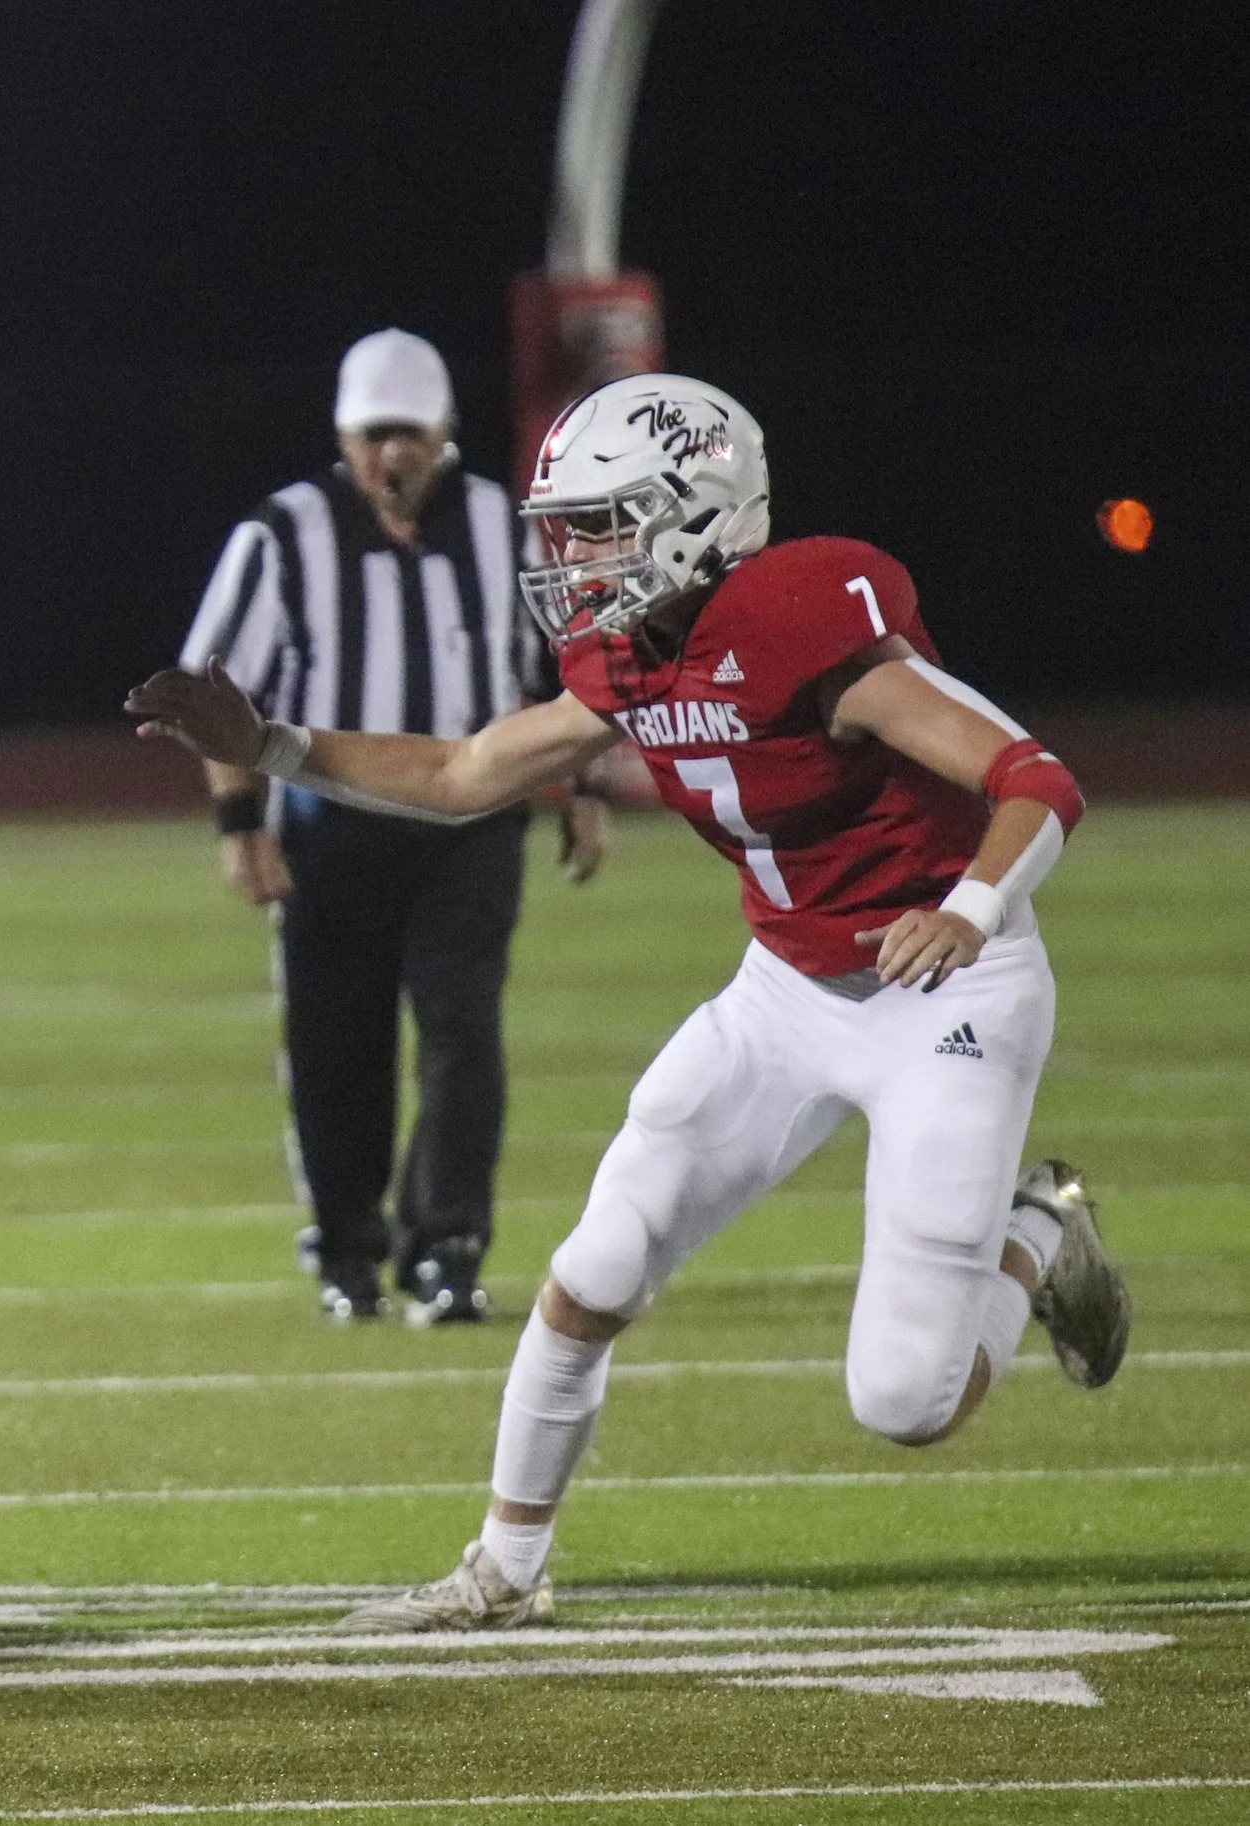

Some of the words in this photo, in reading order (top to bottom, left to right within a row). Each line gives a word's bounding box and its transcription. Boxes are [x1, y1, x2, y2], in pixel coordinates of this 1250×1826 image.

[627, 399, 686, 438] The
[661, 421, 733, 469] Hill
[845, 575, 887, 638] 7
[614, 701, 750, 747] TROJANS
[673, 755, 794, 910] 7
[934, 1042, 985, 1059] adidas
